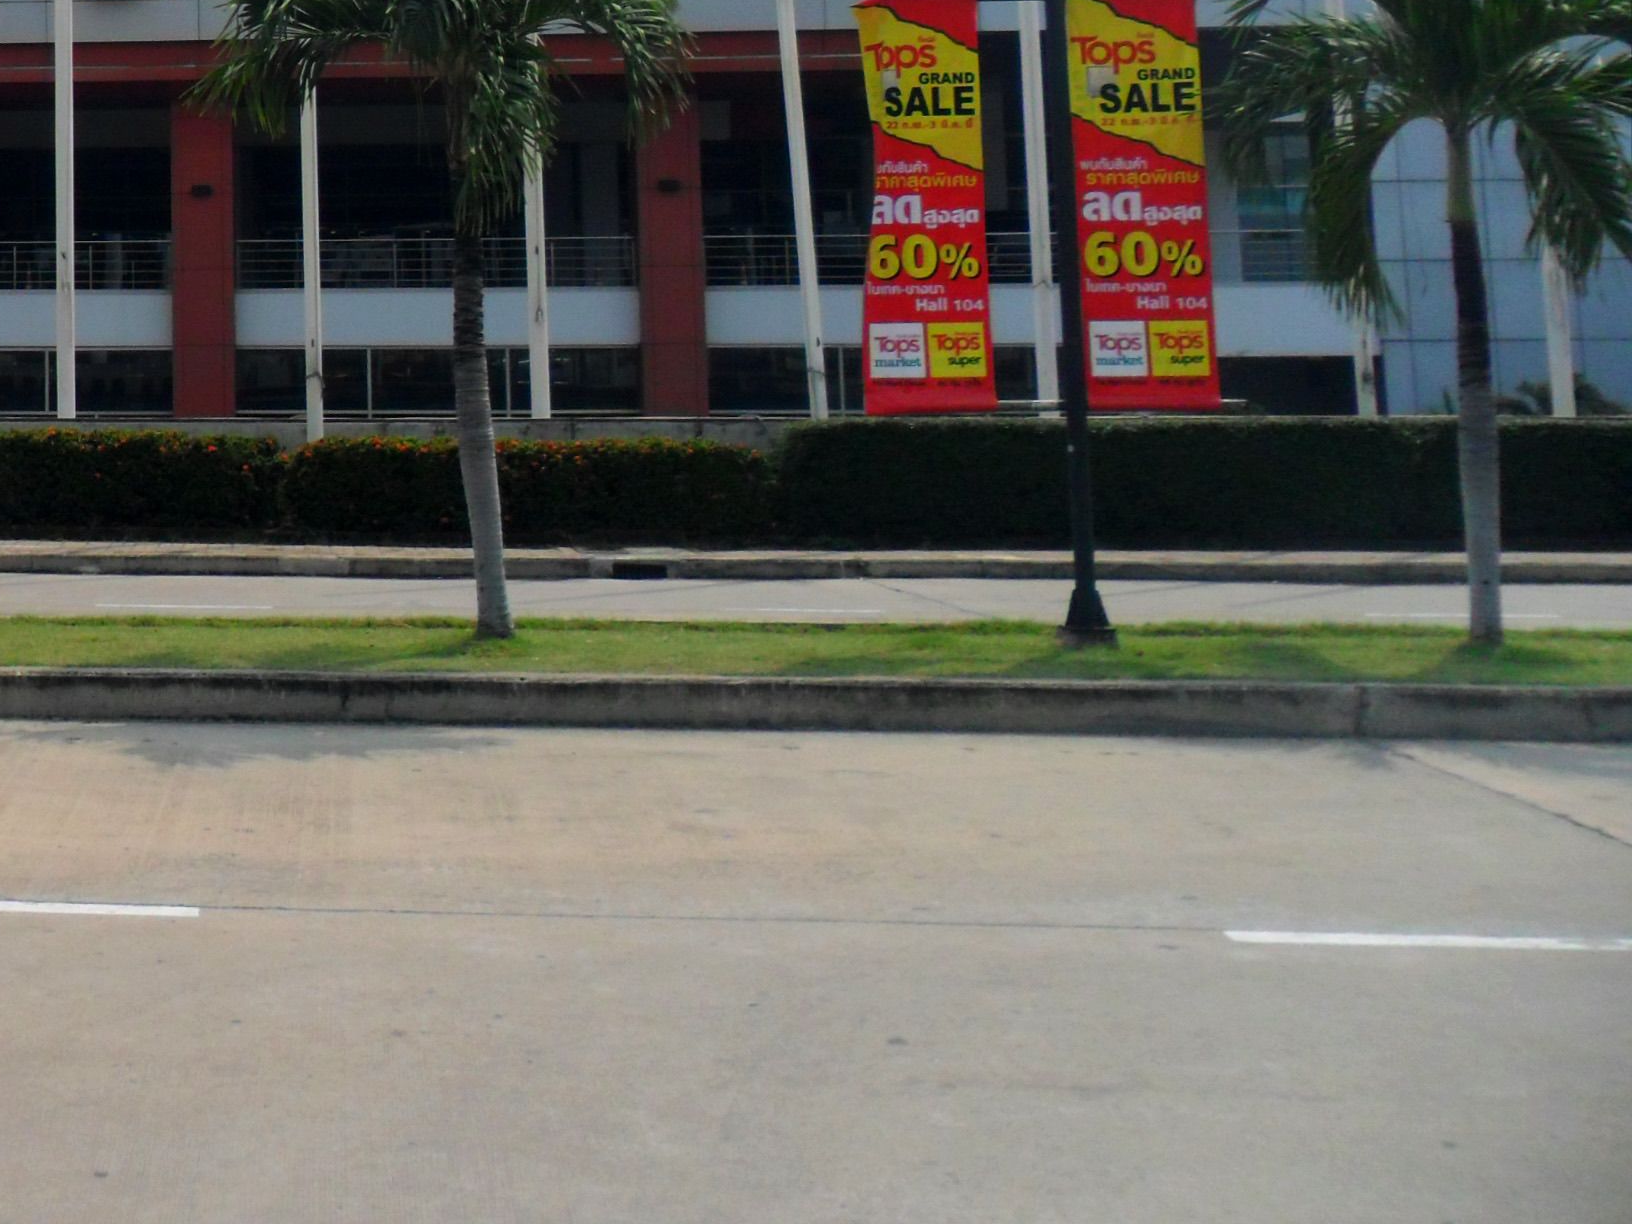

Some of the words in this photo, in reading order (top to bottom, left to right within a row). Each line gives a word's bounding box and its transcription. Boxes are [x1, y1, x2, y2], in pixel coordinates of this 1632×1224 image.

[864, 40, 937, 79] Tops
[1070, 35, 1156, 74] Tops
[918, 72, 975, 85] GRAND
[1137, 68, 1195, 81] GRAND
[884, 86, 976, 117] SALE
[1099, 82, 1196, 114] SALE
[1085, 168, 1200, 188] ราคาสุดพิเศษ
[869, 233, 981, 280] 60%
[1084, 230, 1205, 277] 60%
[915, 298, 948, 312] Hall
[953, 299, 985, 312] 104
[1136, 295, 1169, 309] Hall
[1176, 296, 1208, 309] 104
[874, 335, 921, 358] Tops
[930, 333, 981, 356] Tops
[1094, 333, 1143, 356] Tops
[1152, 331, 1205, 354] Tops
[874, 356, 921, 368] market
[947, 356, 982, 368] super
[1095, 355, 1144, 366] market
[1169, 354, 1205, 366] super
